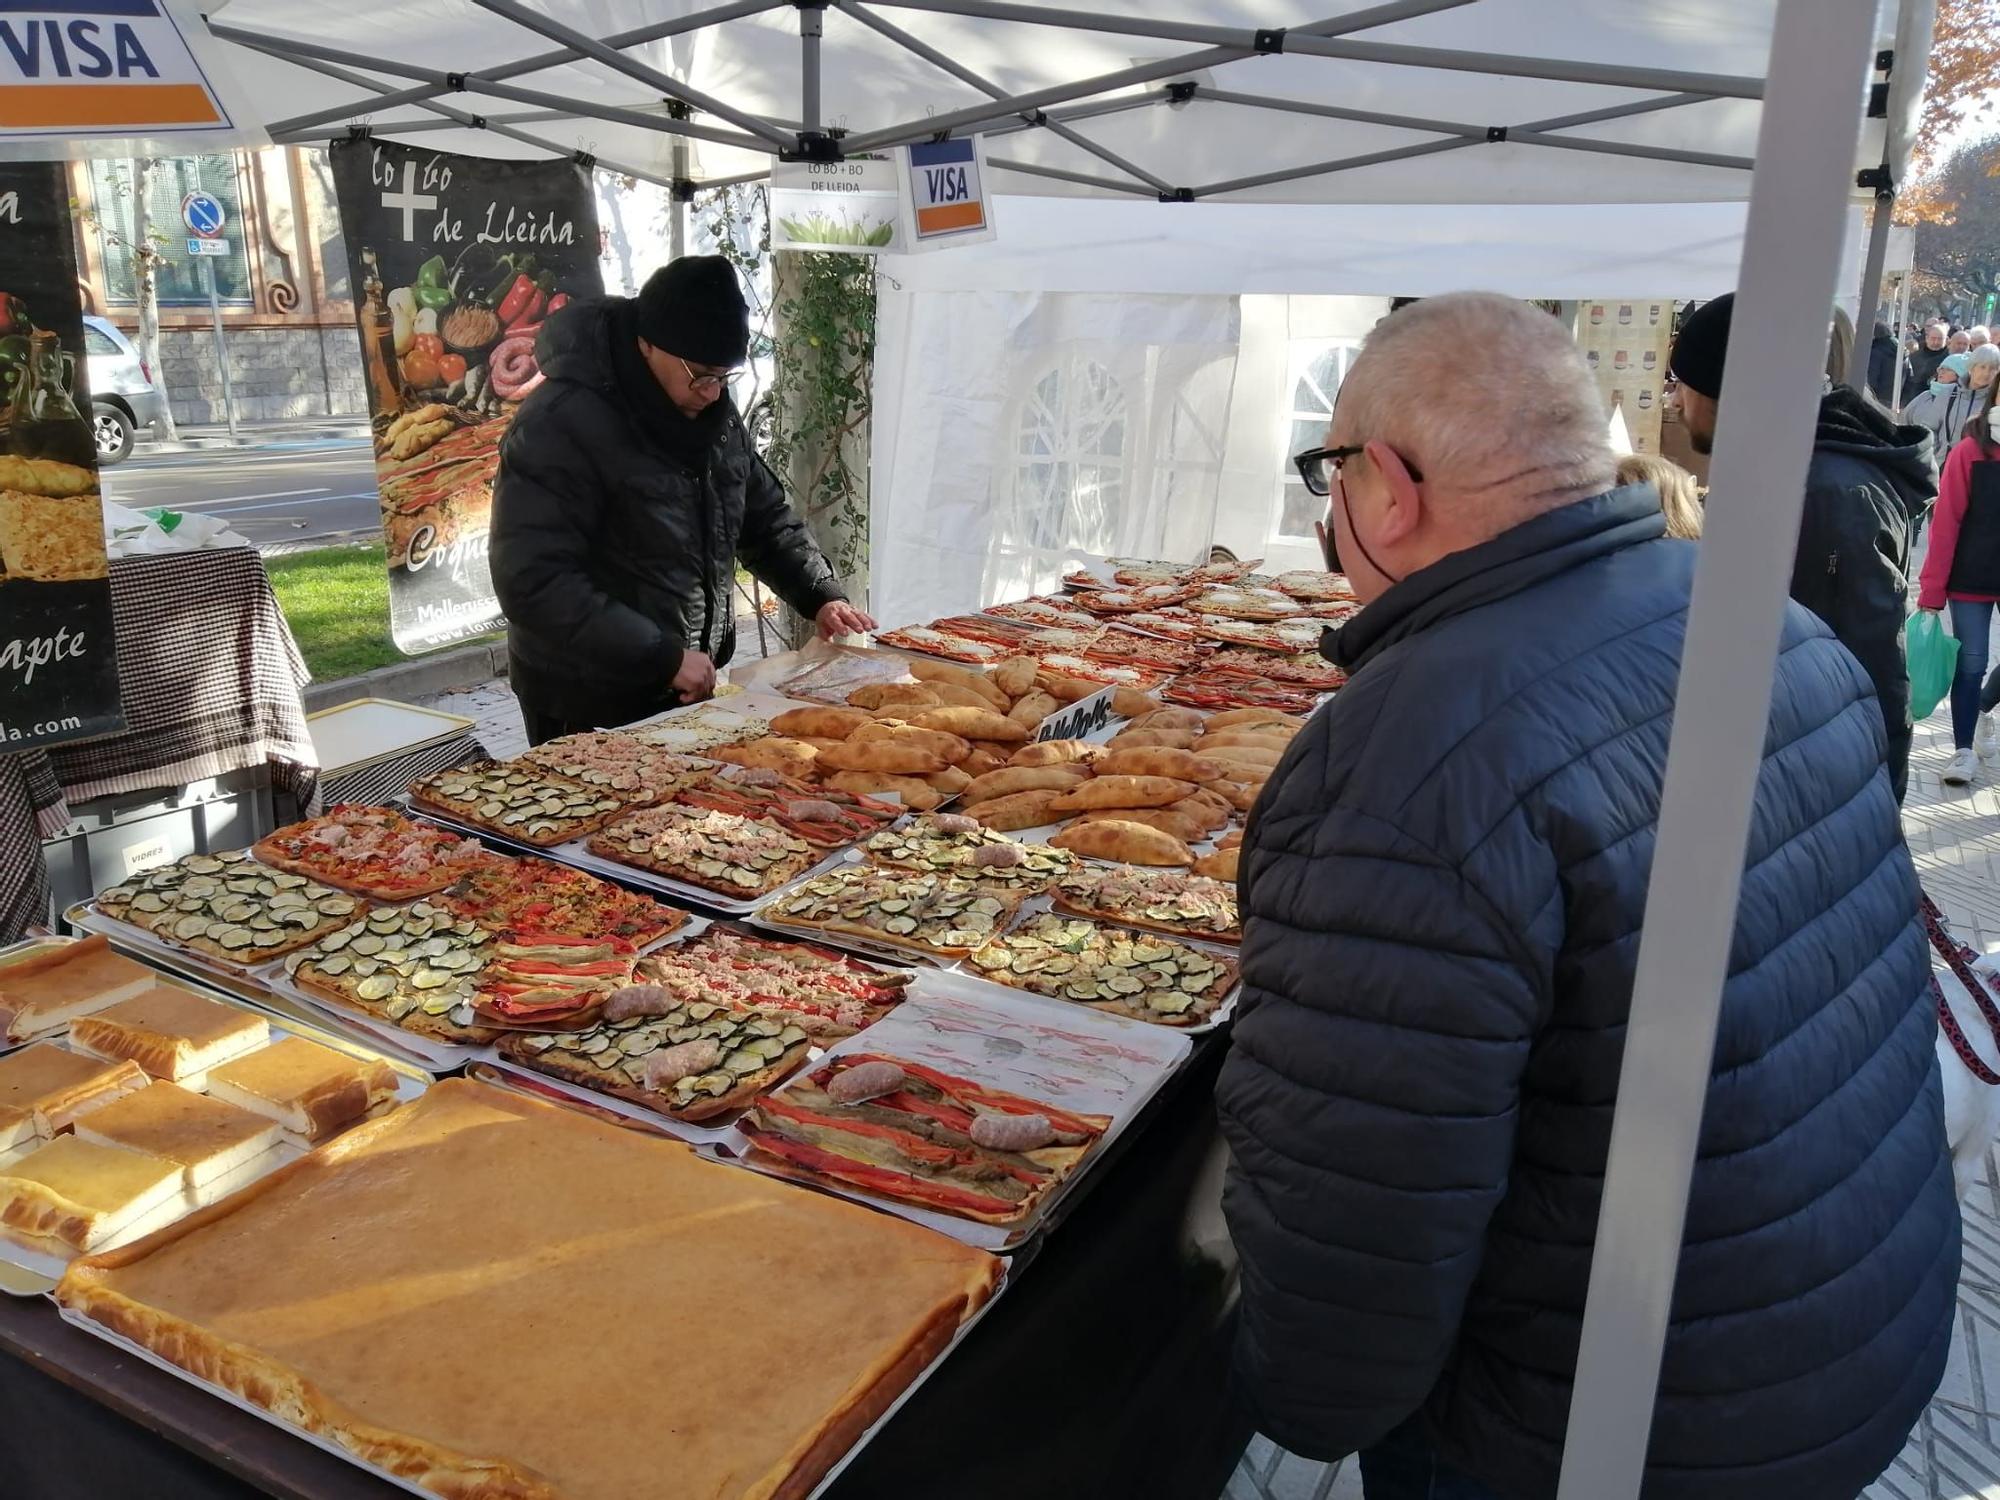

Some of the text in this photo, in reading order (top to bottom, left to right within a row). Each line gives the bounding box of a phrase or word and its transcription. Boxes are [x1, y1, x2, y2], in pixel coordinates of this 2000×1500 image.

[0, 19, 160, 78] VISA
[849, 164, 864, 176] BO
[811, 181, 861, 193] DE LLEIDA
[925, 166, 969, 204] VISA
[433, 201, 575, 246] de Lleida
[131, 846, 164, 864] VIDRES
